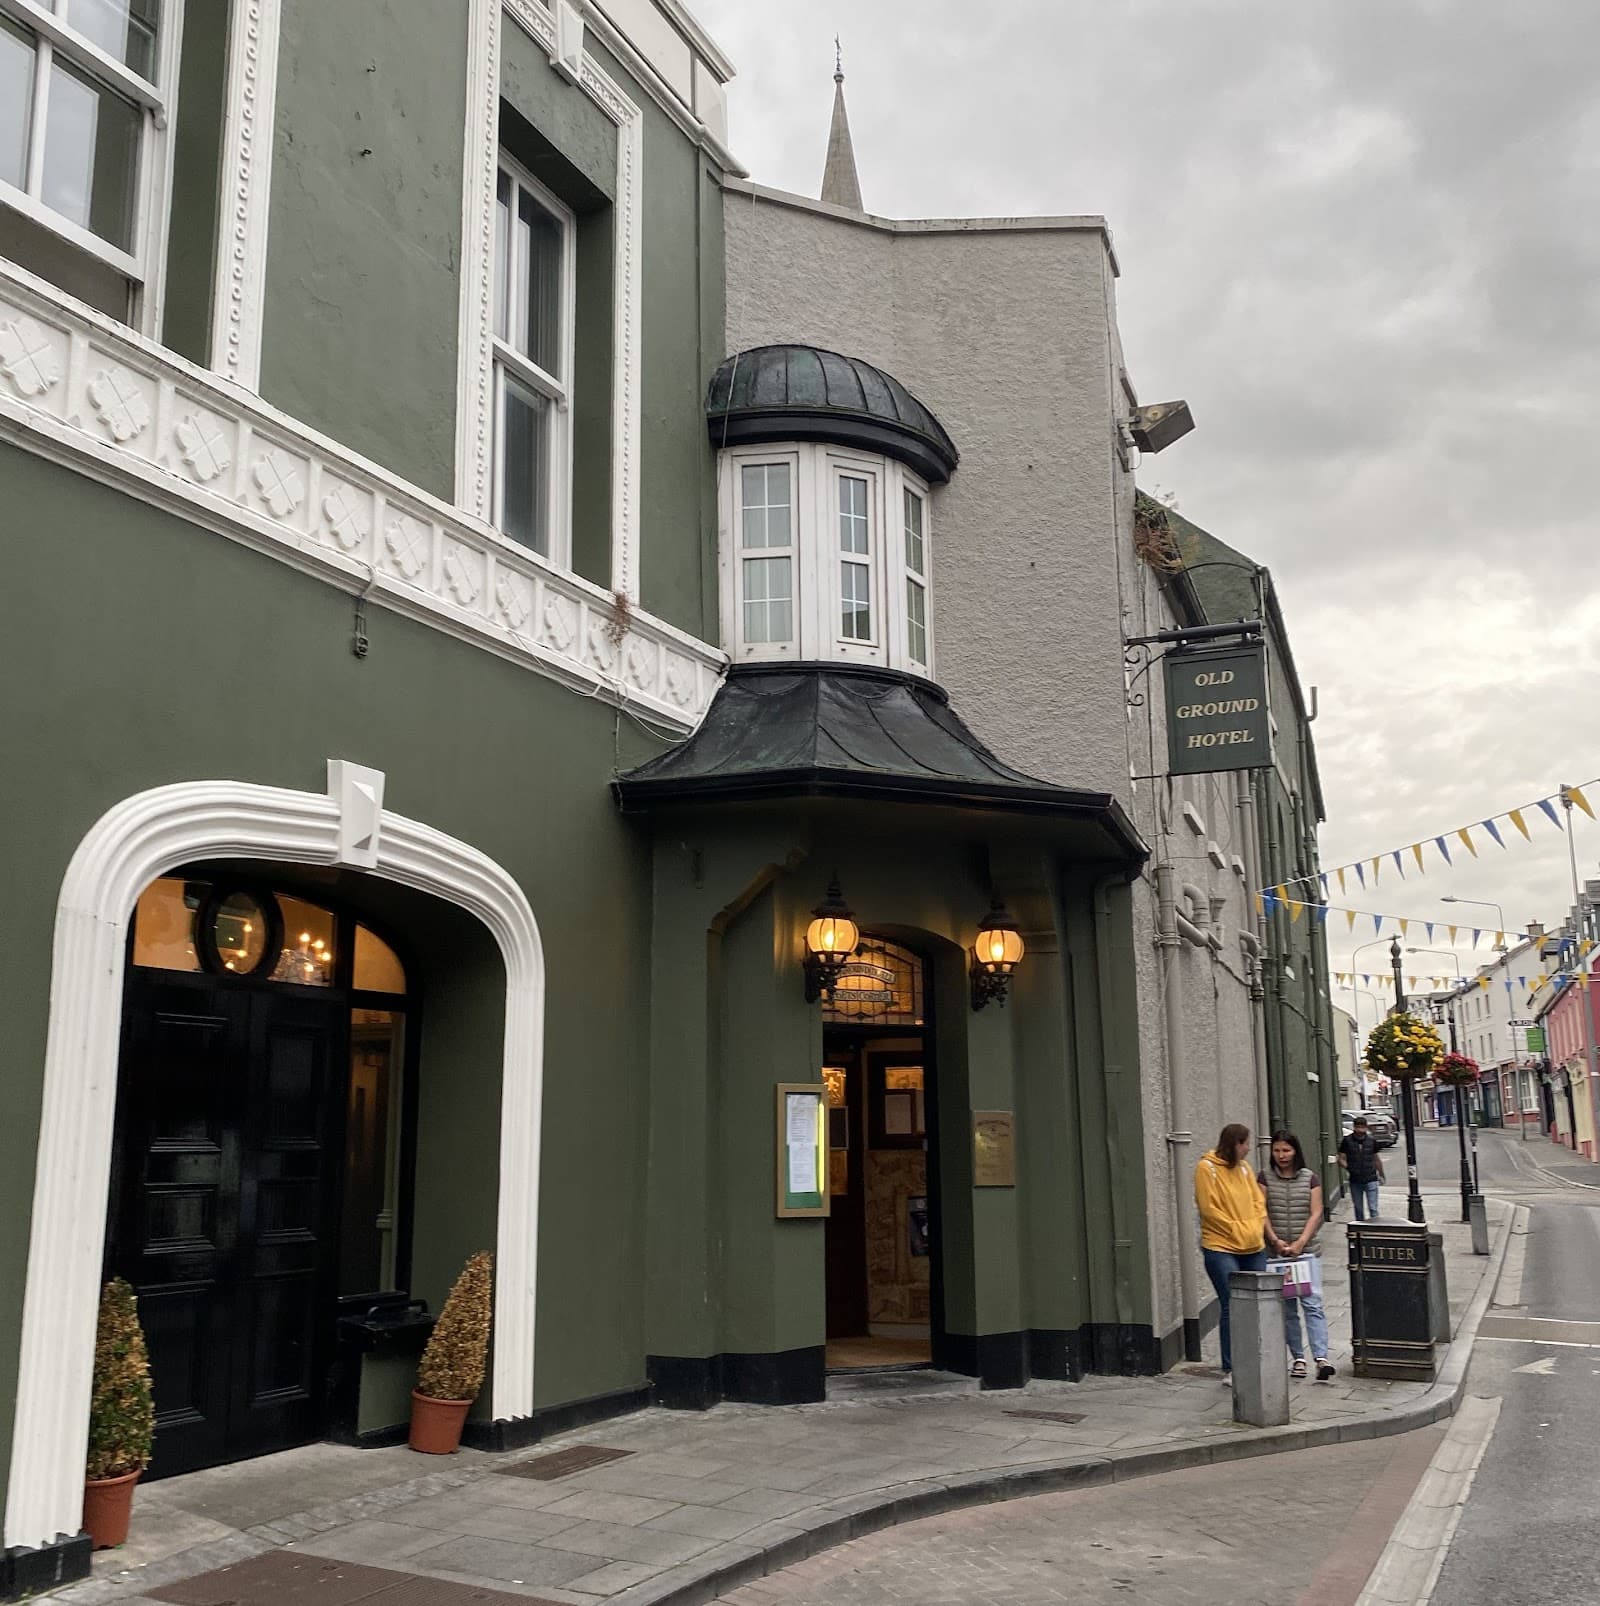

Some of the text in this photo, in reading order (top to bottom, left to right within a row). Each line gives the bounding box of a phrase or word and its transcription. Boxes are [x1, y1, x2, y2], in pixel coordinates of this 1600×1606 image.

[1195, 670, 1234, 687] OLD
[1176, 698, 1258, 719] GROUND
[1186, 729, 1255, 749] HOTEL
[1361, 1246, 1416, 1260] LITTER
